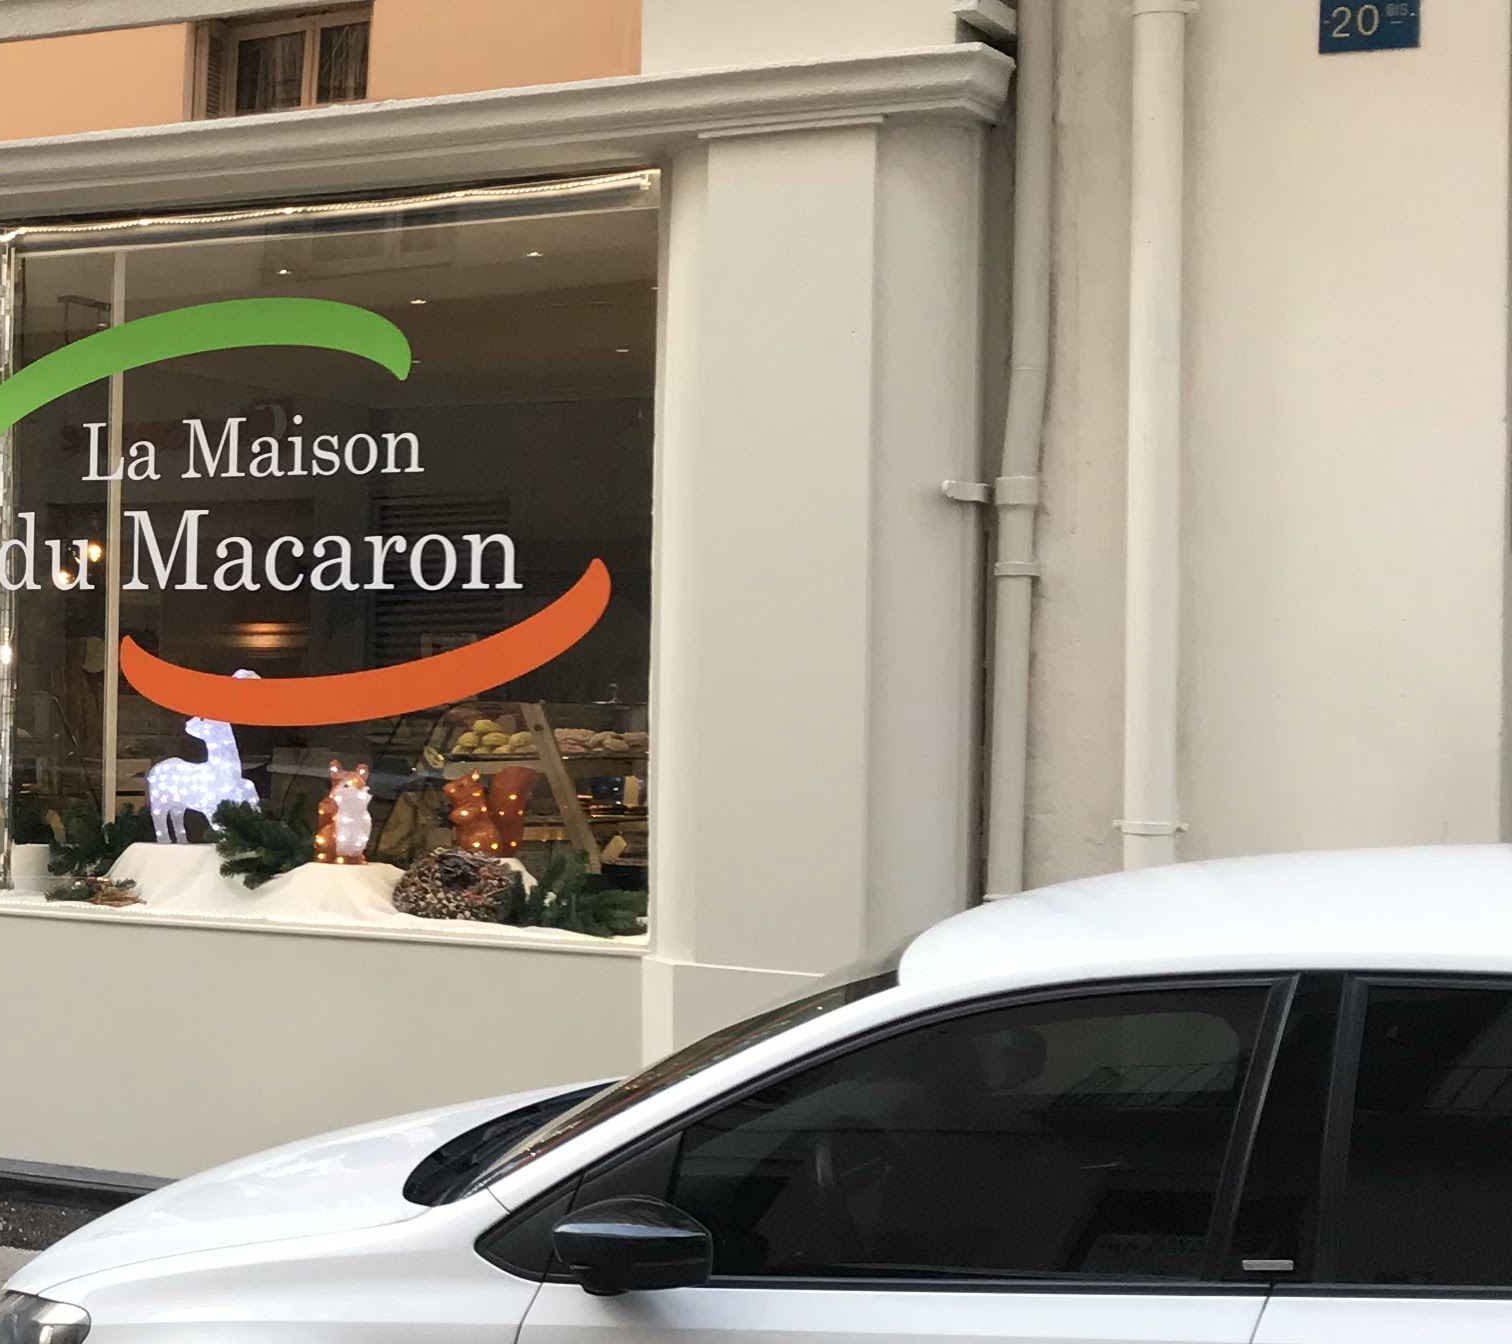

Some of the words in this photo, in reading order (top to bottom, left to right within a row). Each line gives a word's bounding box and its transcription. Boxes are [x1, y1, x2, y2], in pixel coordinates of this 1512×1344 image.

[1332, 4, 1379, 37] 20
[81, 422, 161, 481] La
[181, 414, 425, 479] Maison
[122, 509, 524, 592] Macaron
